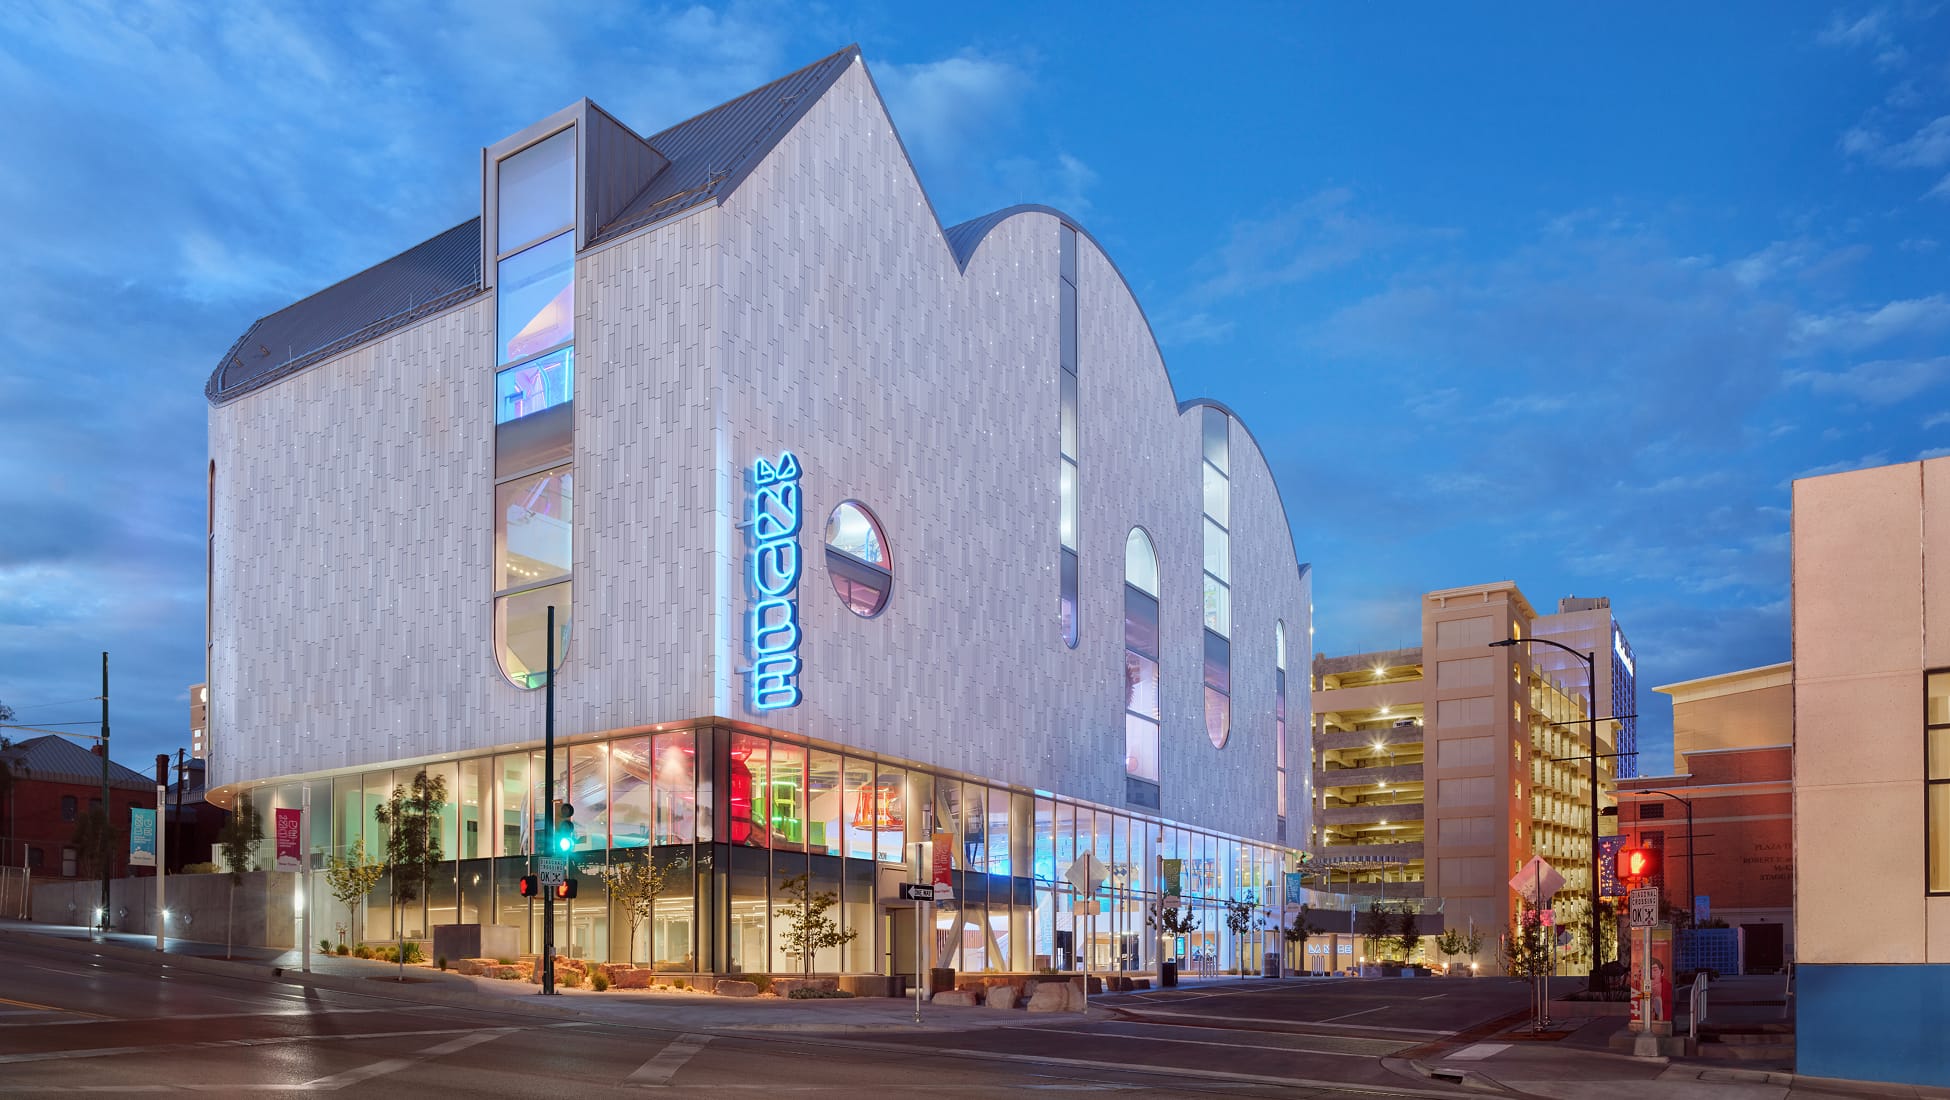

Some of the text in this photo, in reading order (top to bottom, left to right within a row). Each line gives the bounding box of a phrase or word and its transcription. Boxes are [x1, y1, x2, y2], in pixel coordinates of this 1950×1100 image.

[541, 871, 550, 882] OK
[1632, 890, 1656, 898] DIAGONAL
[1632, 897, 1656, 905] CROSSING
[1632, 908, 1642, 922] OK
[1308, 943, 1321, 954] LA
